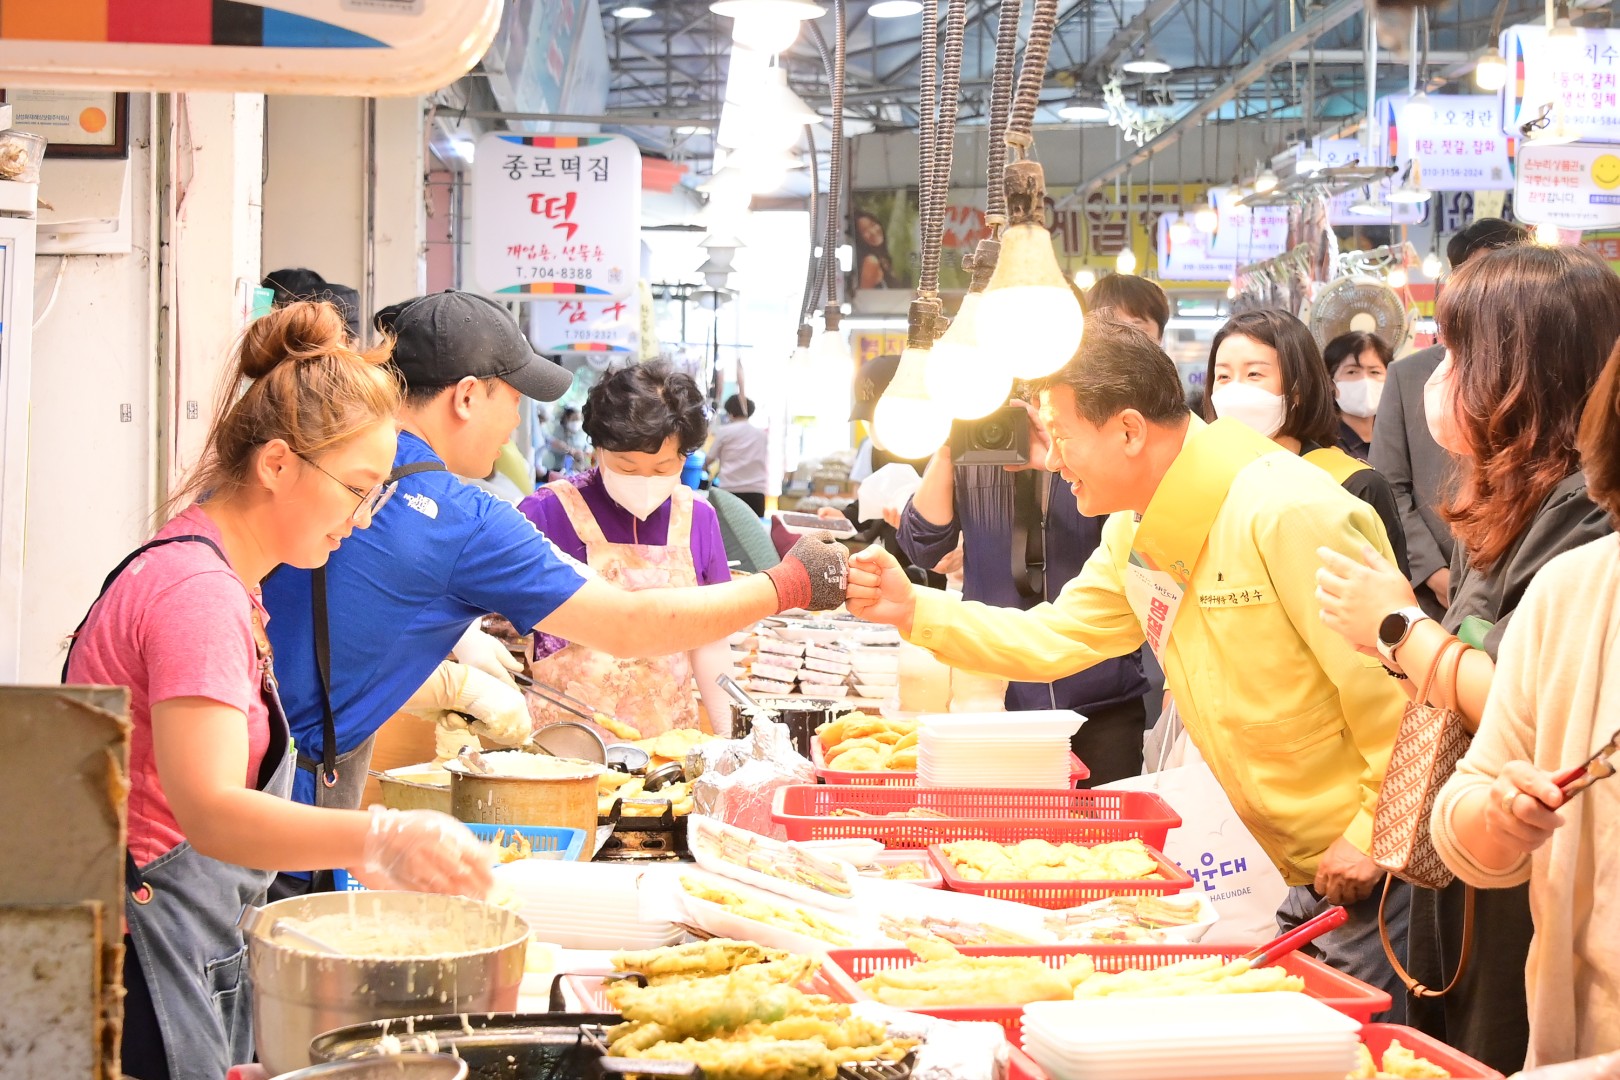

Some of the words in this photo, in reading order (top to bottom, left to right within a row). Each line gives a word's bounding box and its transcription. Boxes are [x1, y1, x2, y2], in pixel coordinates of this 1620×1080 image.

[502, 154, 609, 182] 종로떡집
[527, 191, 579, 242] 떡
[1209, 886, 1252, 903] HAEUNDAE
